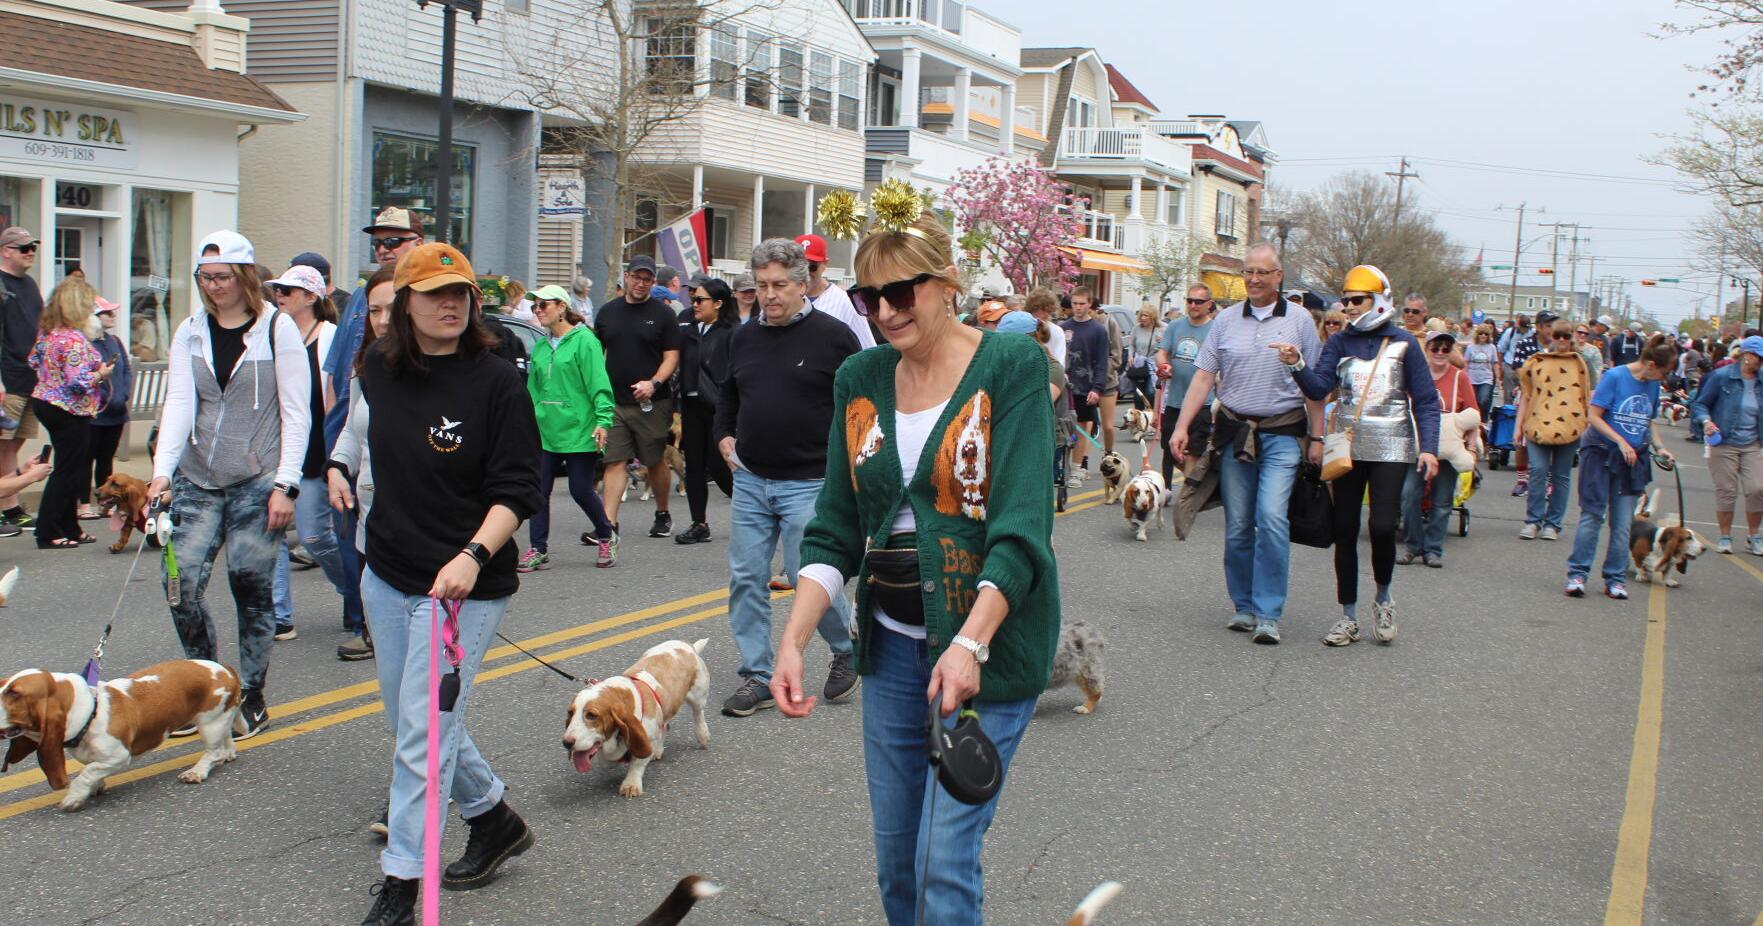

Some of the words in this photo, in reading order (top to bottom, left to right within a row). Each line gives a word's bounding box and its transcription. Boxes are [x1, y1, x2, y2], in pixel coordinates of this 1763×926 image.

[42, 108, 71, 137] N'
[78, 114, 124, 144] SPA
[24, 142, 96, 161] 609-391-1818
[430, 426, 463, 444] VANS
[938, 537, 979, 575] Bas
